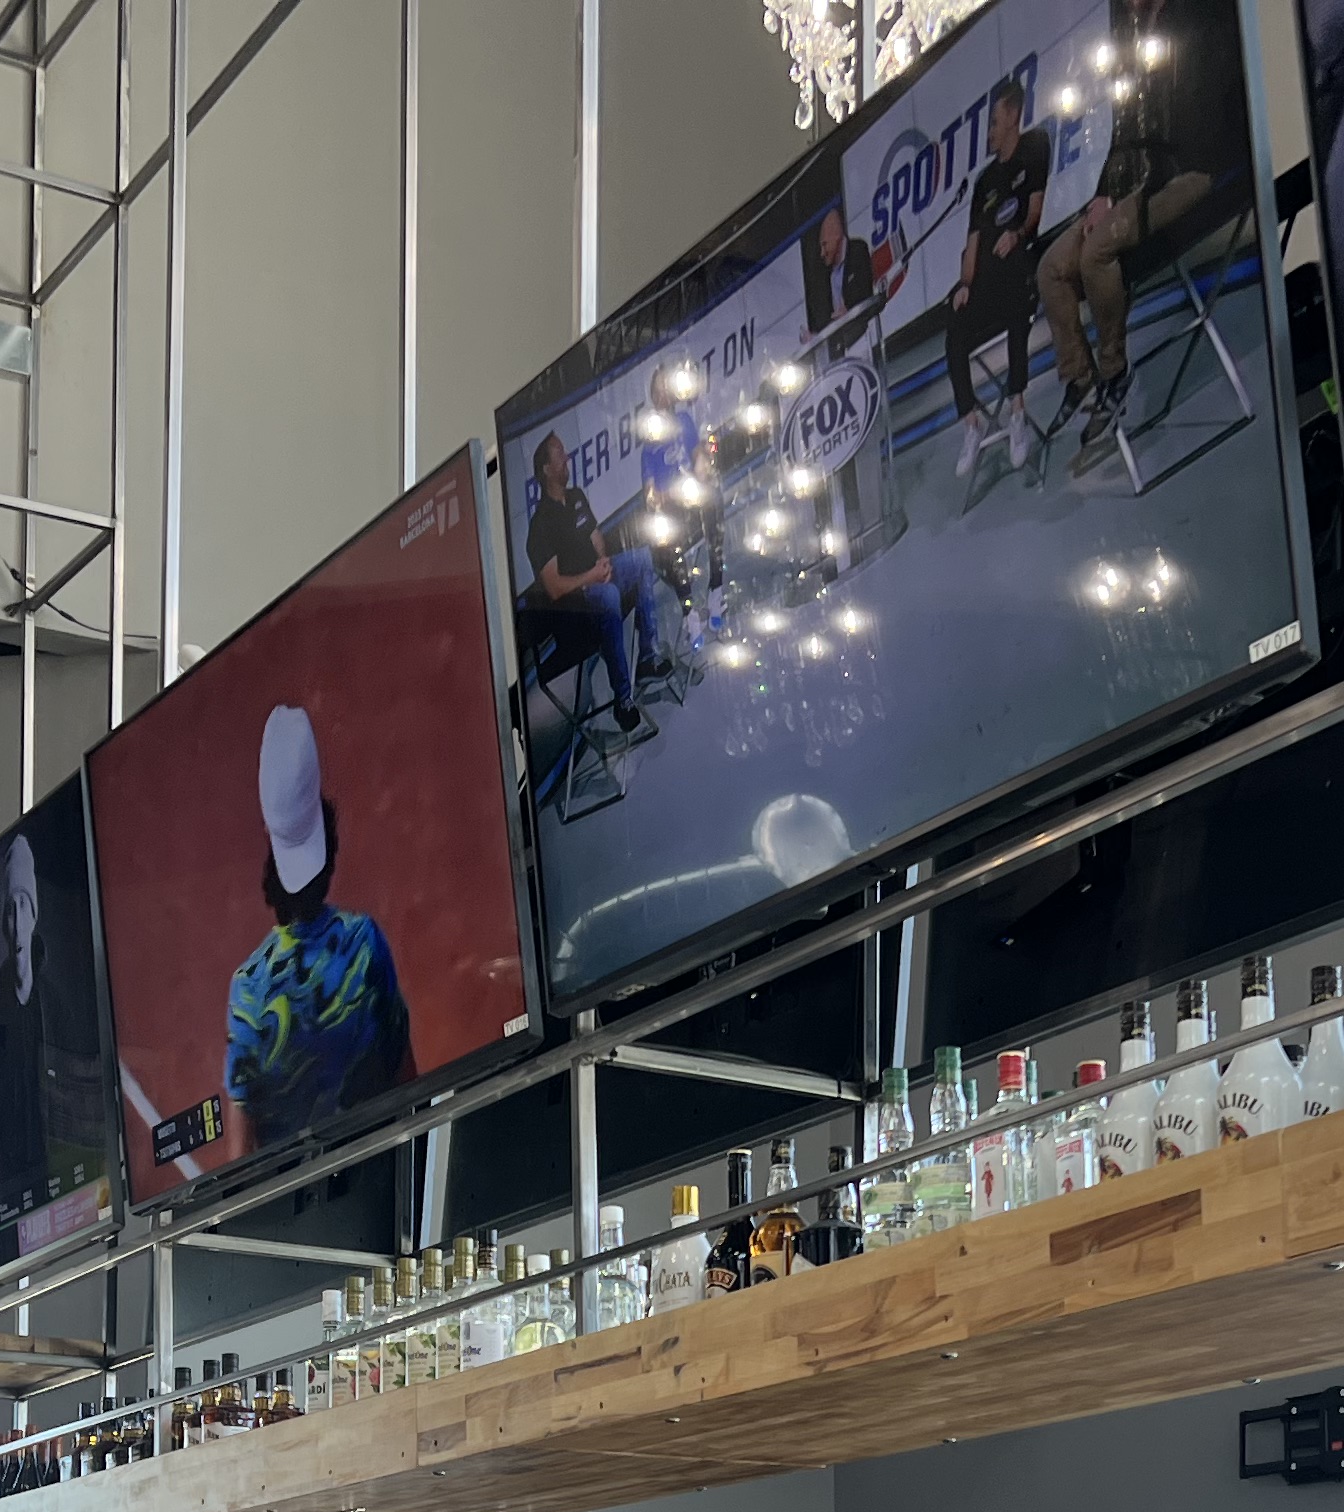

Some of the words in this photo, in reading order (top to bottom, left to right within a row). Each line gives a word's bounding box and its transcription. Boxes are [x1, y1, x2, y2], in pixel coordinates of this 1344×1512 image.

[723, 317, 756, 378] ON
[800, 375, 857, 450] FOX
[1253, 638, 1270, 658] TV
[1274, 625, 1296, 648] 017
[1217, 1092, 1264, 1115] ALIBU
[1154, 1114, 1198, 1136] ALIBU
[1096, 1132, 1137, 1154] ALIBU
